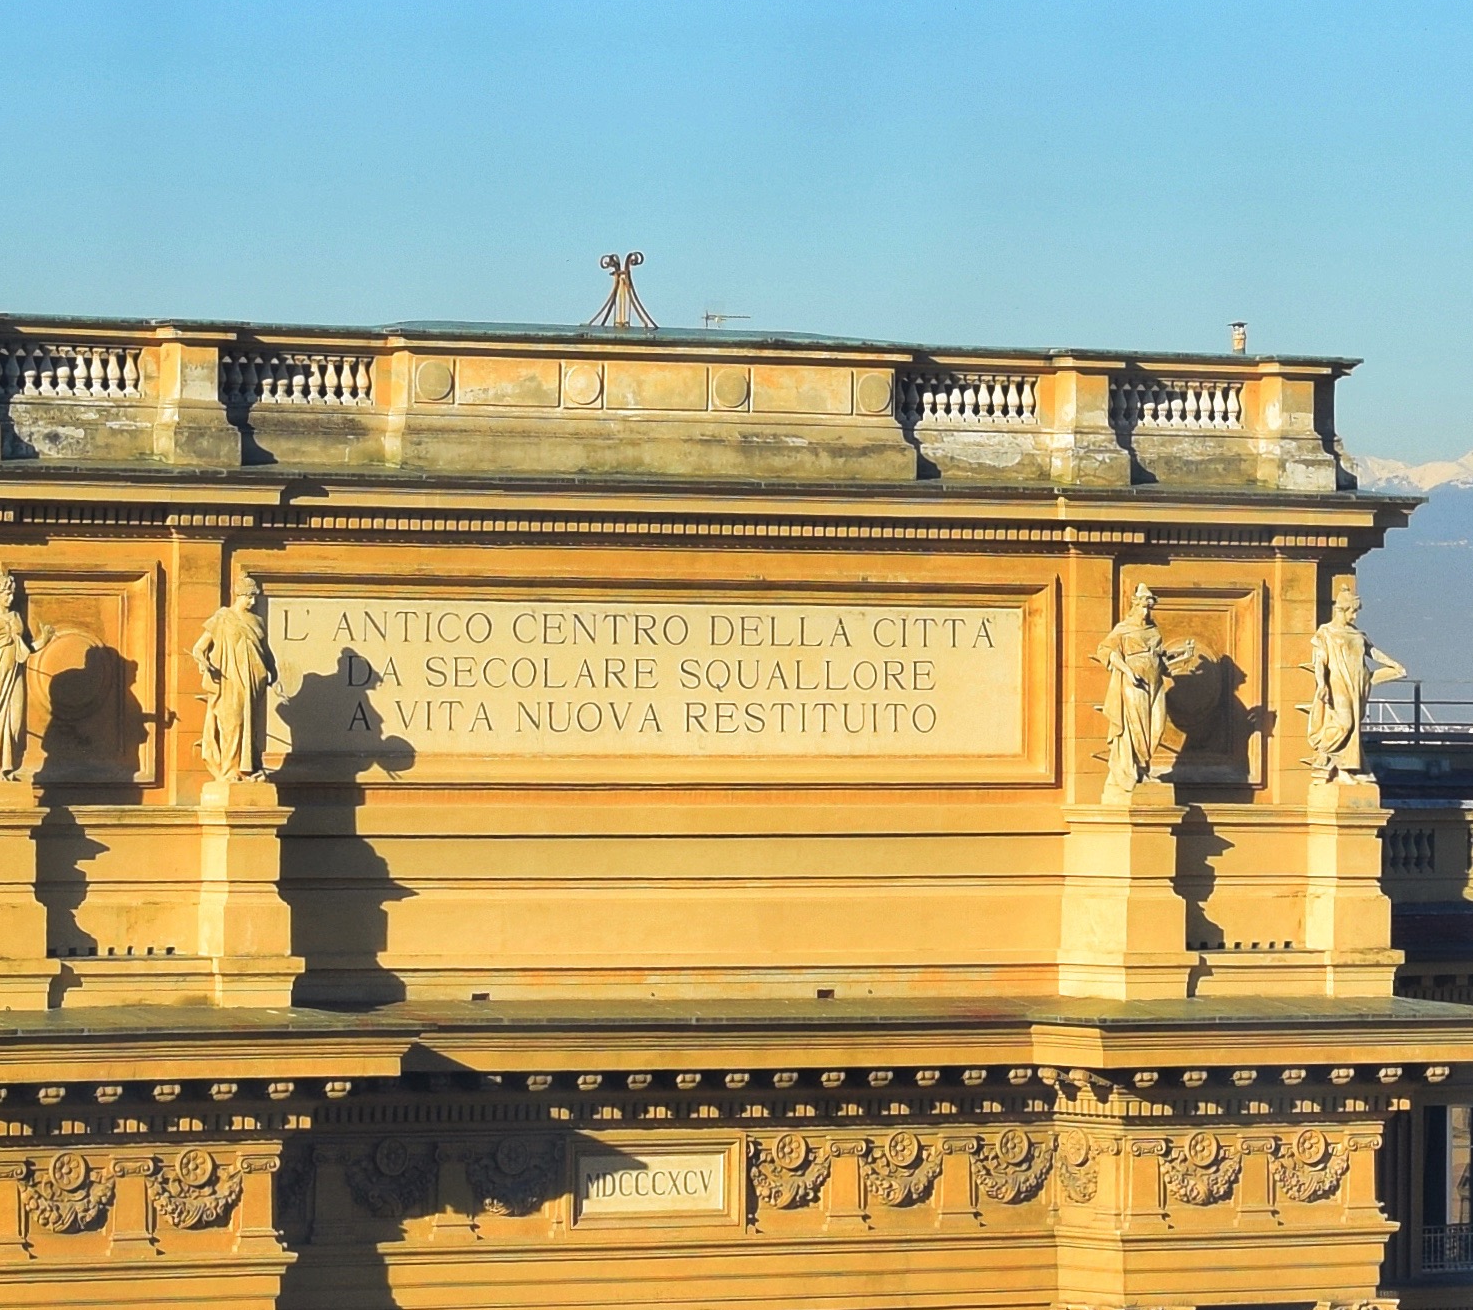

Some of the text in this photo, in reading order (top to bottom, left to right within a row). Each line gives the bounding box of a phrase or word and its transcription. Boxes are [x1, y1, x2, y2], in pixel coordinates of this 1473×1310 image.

[512, 612, 689, 646] CENTRO
[709, 615, 853, 648] DELLA
[873, 616, 997, 649] CITTÀ
[347, 655, 938, 692] DA SECOLARE SQUALLORE
[347, 700, 938, 734] A VITA NUOVA RESTITUITO
[586, 1169, 713, 1198] MDCCCXCV
